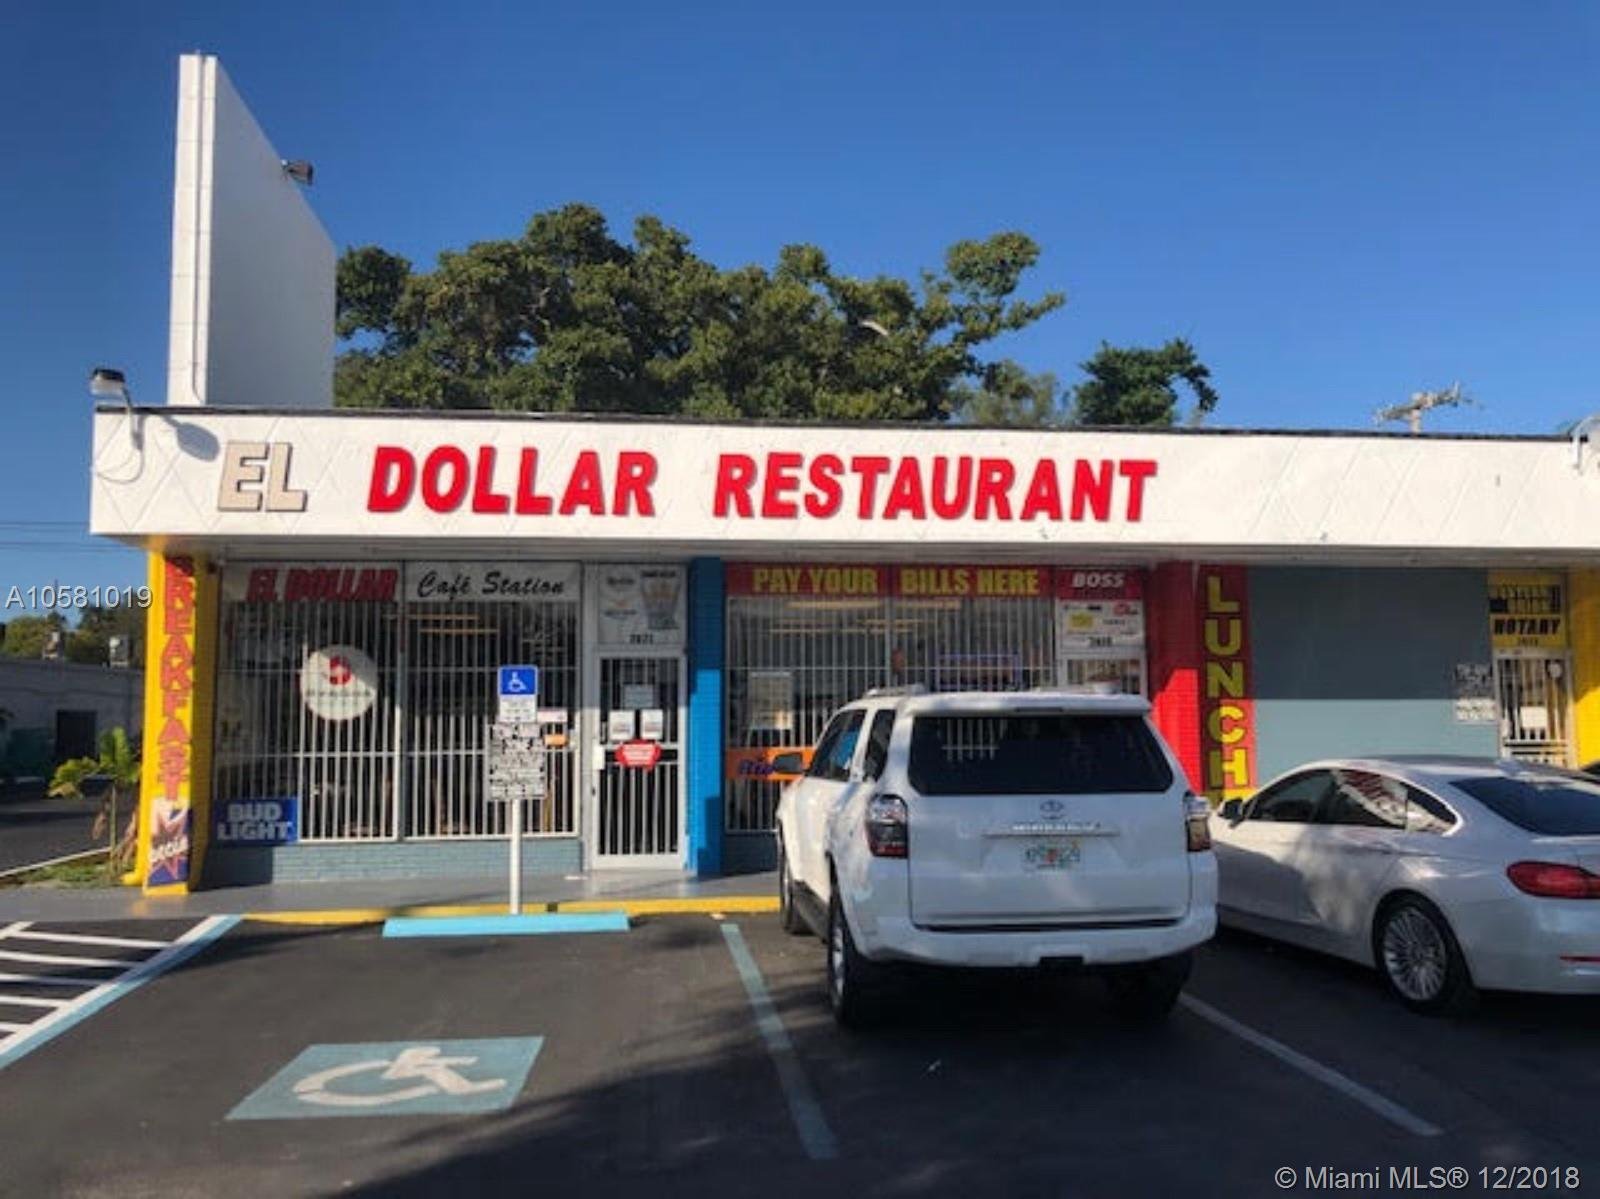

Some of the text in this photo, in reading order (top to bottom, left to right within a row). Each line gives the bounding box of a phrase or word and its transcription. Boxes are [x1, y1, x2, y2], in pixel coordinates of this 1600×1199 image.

[217, 441, 1158, 523] EL DOLLAR RESTAURANT
[248, 569, 398, 602] EL DOLLAR
[417, 571, 565, 599] Café Station
[754, 567, 801, 593] PAY
[807, 567, 878, 594] YOUR
[902, 568, 969, 595] BILLS
[1072, 572, 1125, 588] BOSS
[1494, 618, 1561, 635] NOTARY
[157, 555, 196, 799] BREAKFAST
[1204, 575, 1249, 787] LUNCH
[227, 802, 282, 822] BUD
[217, 821, 294, 840] LIGHT
